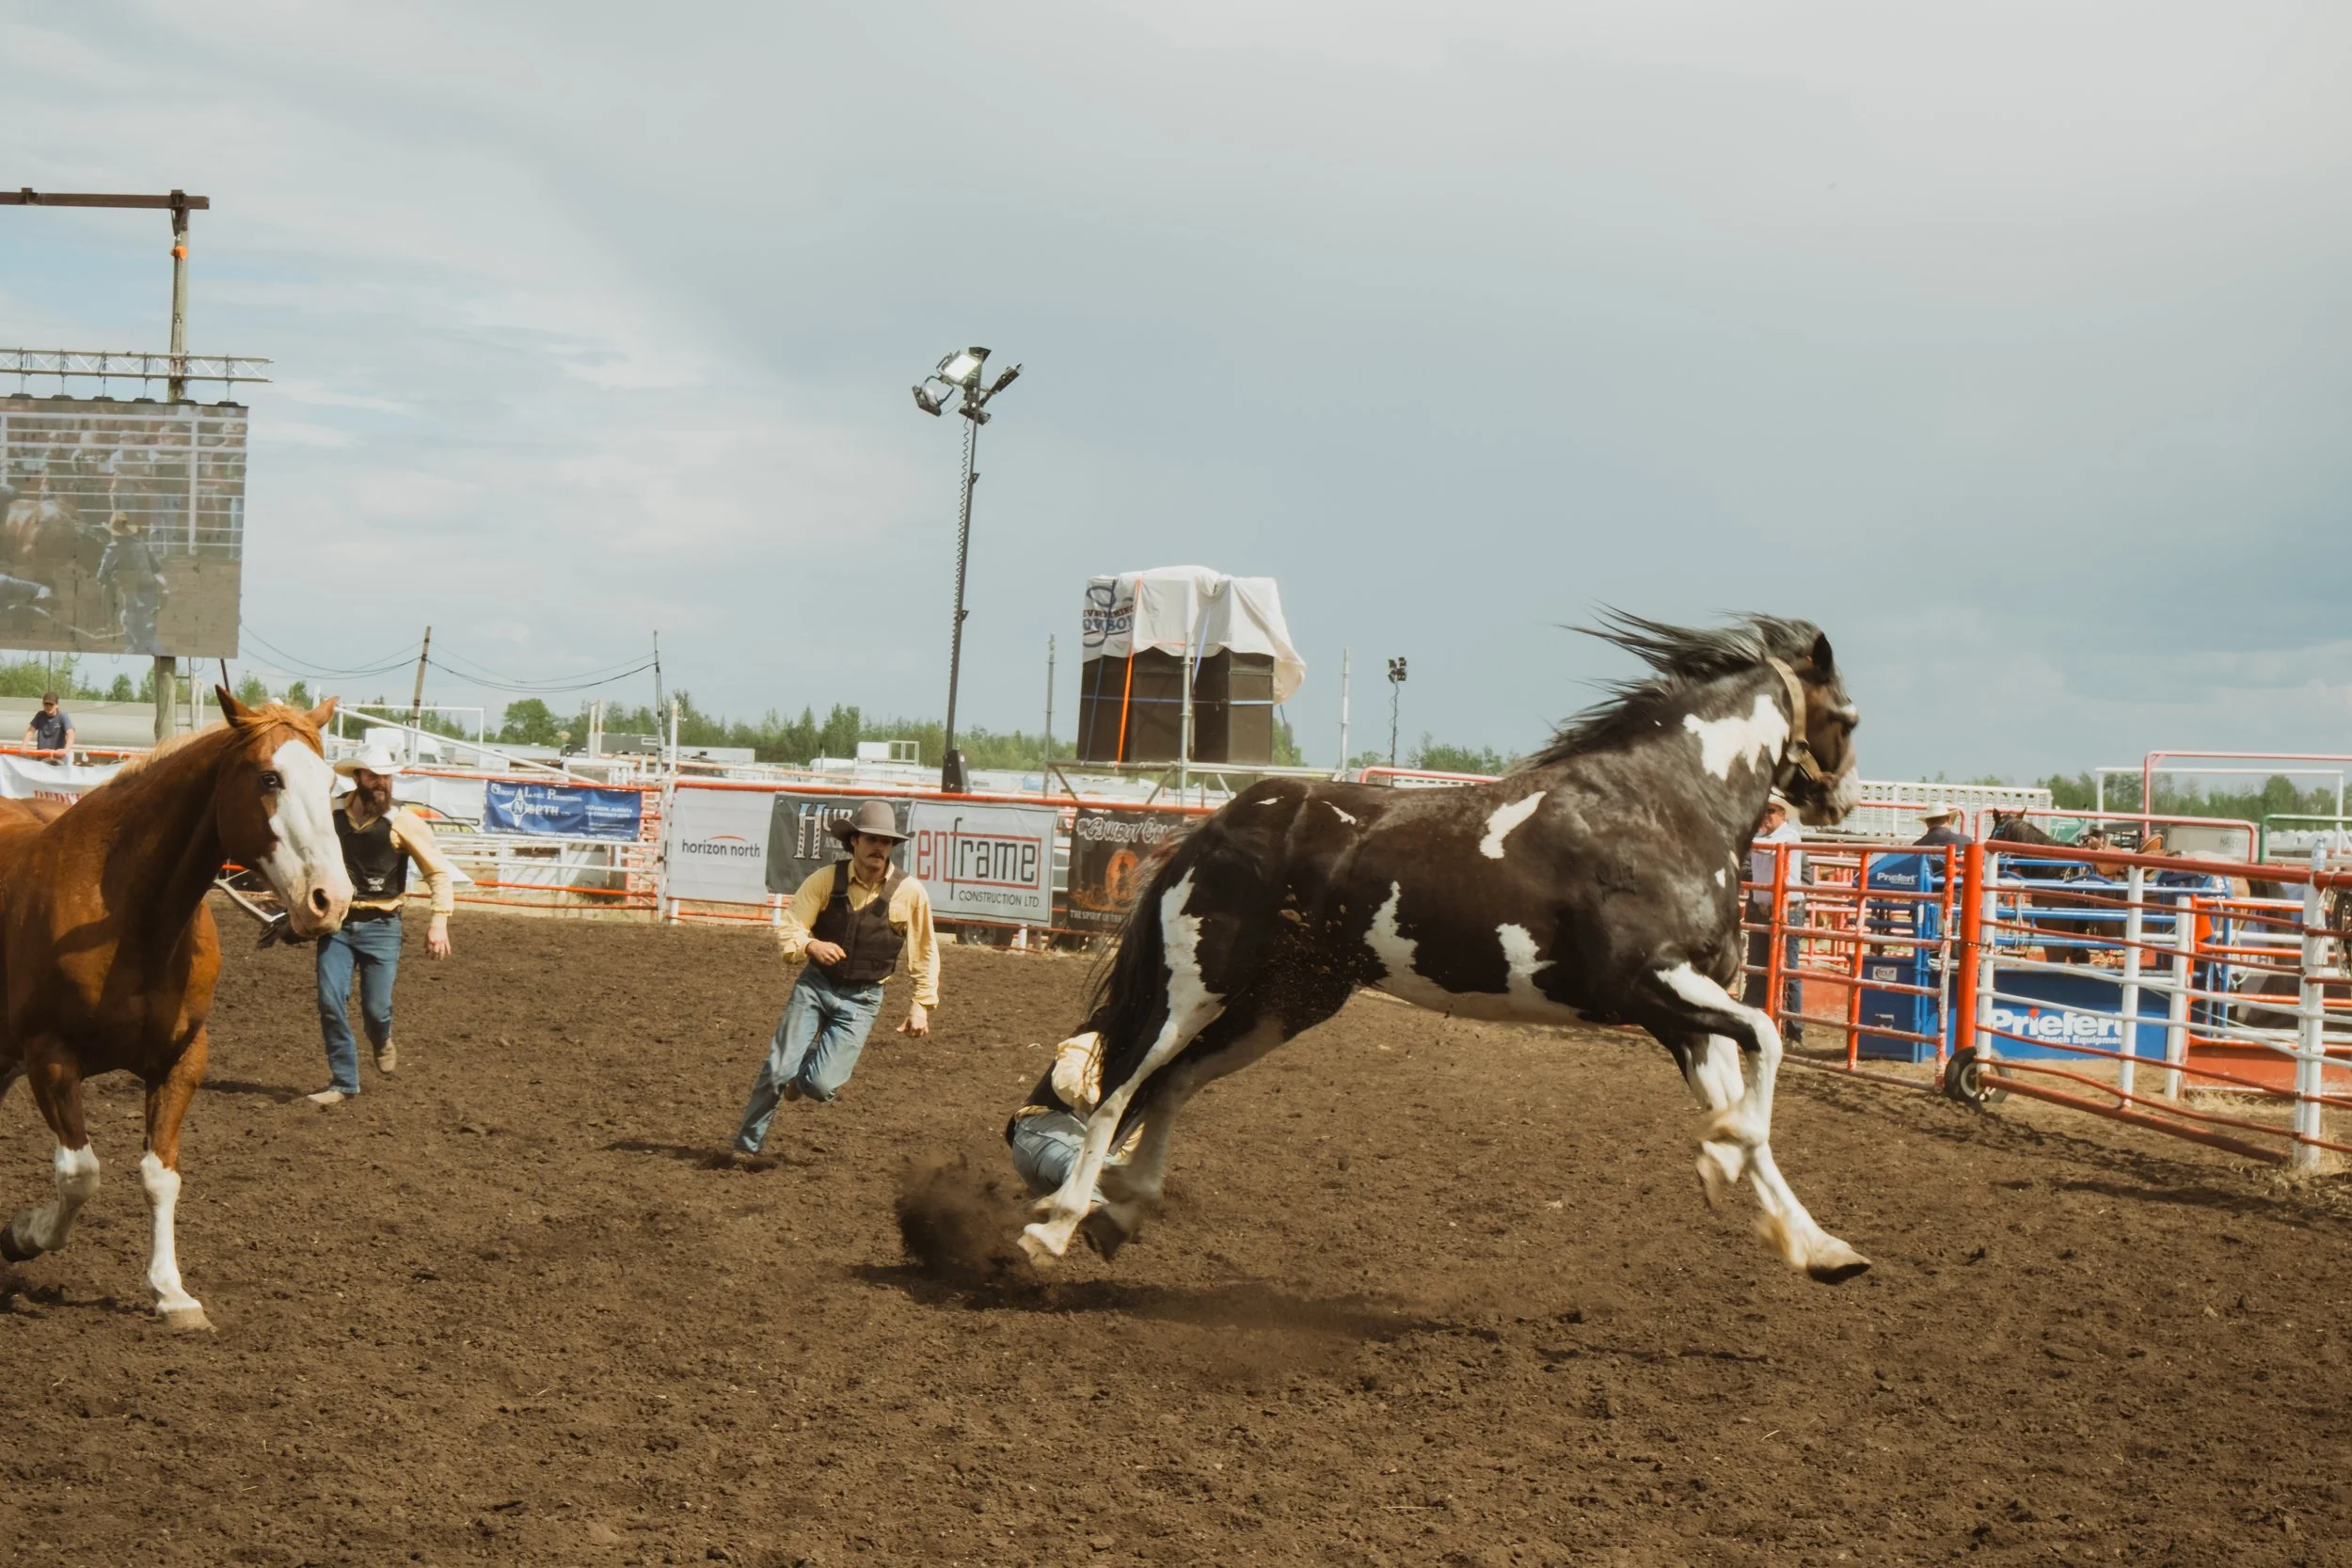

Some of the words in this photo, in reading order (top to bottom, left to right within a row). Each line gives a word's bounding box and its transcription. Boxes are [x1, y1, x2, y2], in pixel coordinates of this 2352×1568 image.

[1083, 606, 1134, 618] EVERYHIN
[1083, 616, 1133, 631] OWBOY
[682, 839, 727, 856] horizon
[730, 842, 760, 858] north
[917, 817, 1036, 900] enframe
[1877, 872, 1915, 882] Priefert
[959, 890, 1022, 906] CONSTRUCTION
[1991, 1007, 2122, 1036] Priefert
[2072, 1036, 2122, 1046] Equipme
